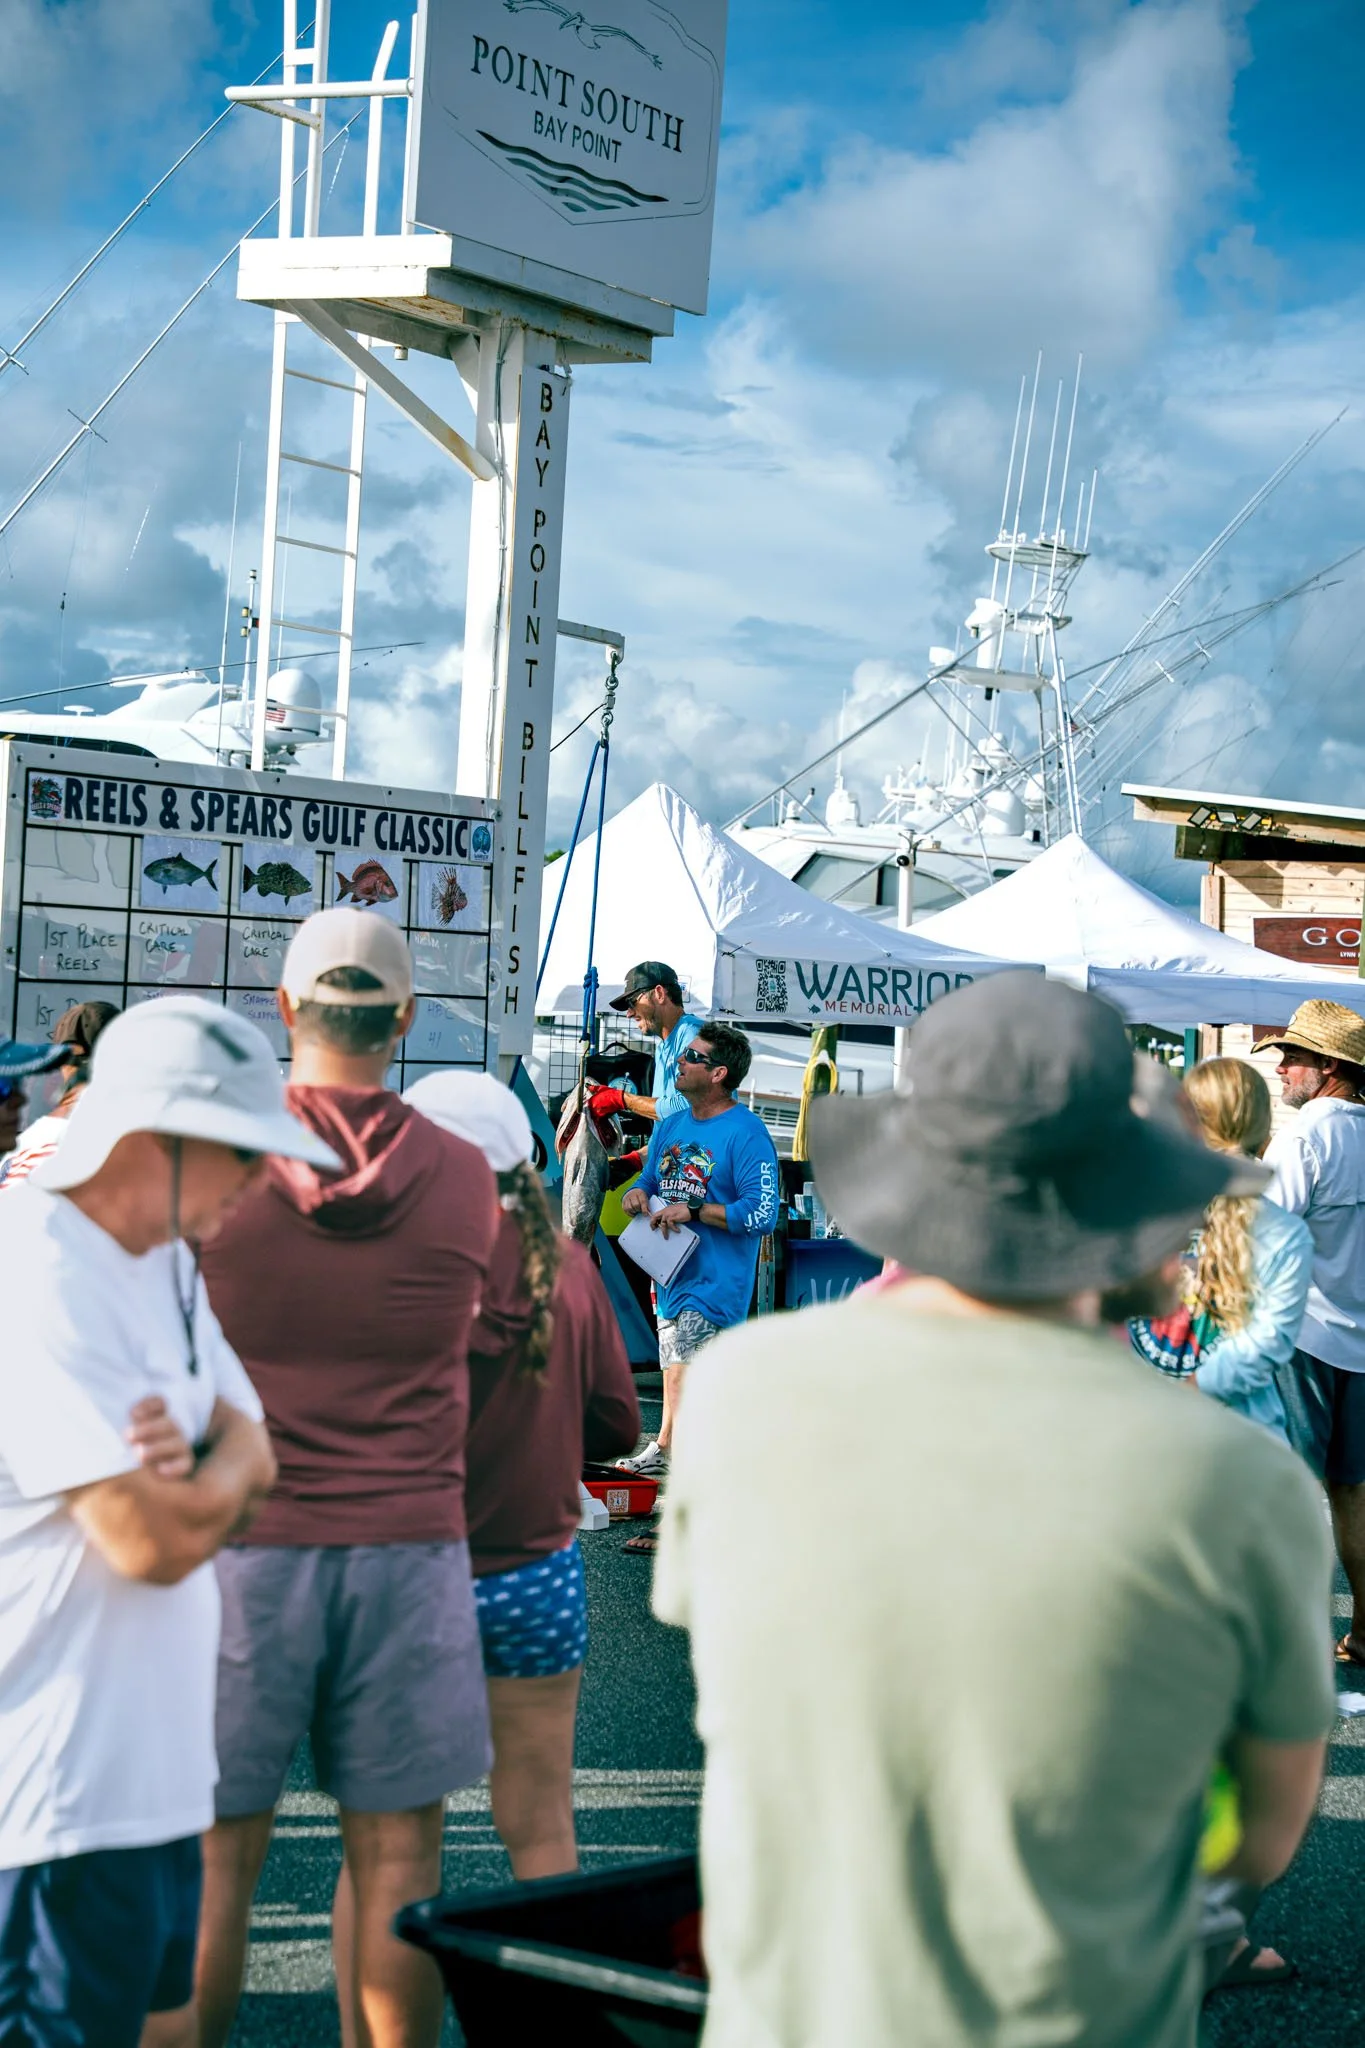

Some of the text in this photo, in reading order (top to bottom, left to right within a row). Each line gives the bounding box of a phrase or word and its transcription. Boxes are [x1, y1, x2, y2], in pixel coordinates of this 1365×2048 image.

[470, 35, 684, 153] POINT SOUTH
[533, 110, 622, 163] BAY POINT
[504, 382, 552, 1014] BAY POINT BILLFISH
[64, 777, 468, 858] REELS & SPEARS GULF CLASSIC
[77, 923, 118, 949] PLACE
[138, 921, 189, 936] CRITICAL
[242, 926, 293, 941] CRITICAL
[145, 938, 177, 953] CARE
[243, 946, 269, 958] CARE
[56, 953, 100, 972] REELS
[825, 1000, 912, 1017] MEMORIAL
[678, 1179, 707, 1198] SPEARS
